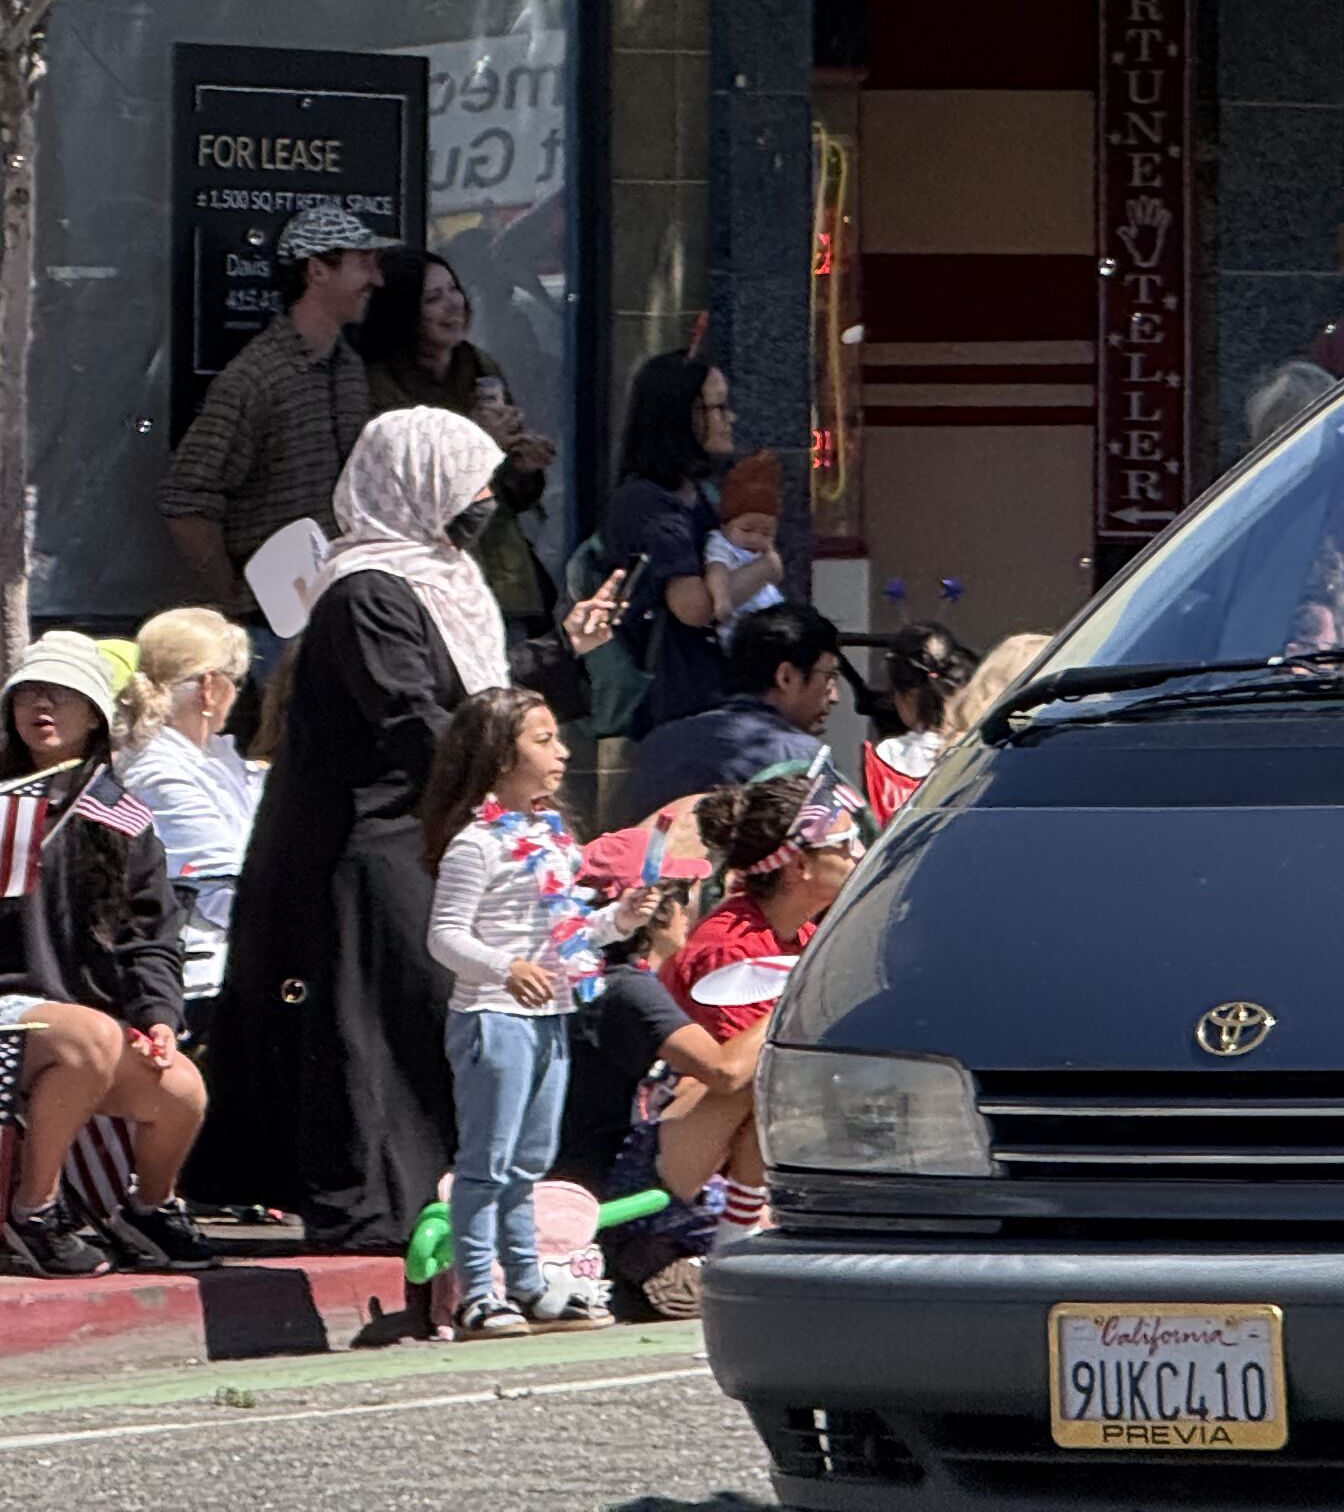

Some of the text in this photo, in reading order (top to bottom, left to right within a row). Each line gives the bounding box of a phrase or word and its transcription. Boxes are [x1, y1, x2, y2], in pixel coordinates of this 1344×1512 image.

[197, 134, 343, 173] FOR LEASE
[1120, 274, 1166, 500] TELLER
[1101, 1316, 1238, 1356] California
[1072, 1359, 1268, 1423] 9UKC410
[1102, 1425, 1234, 1446] PREVIA
